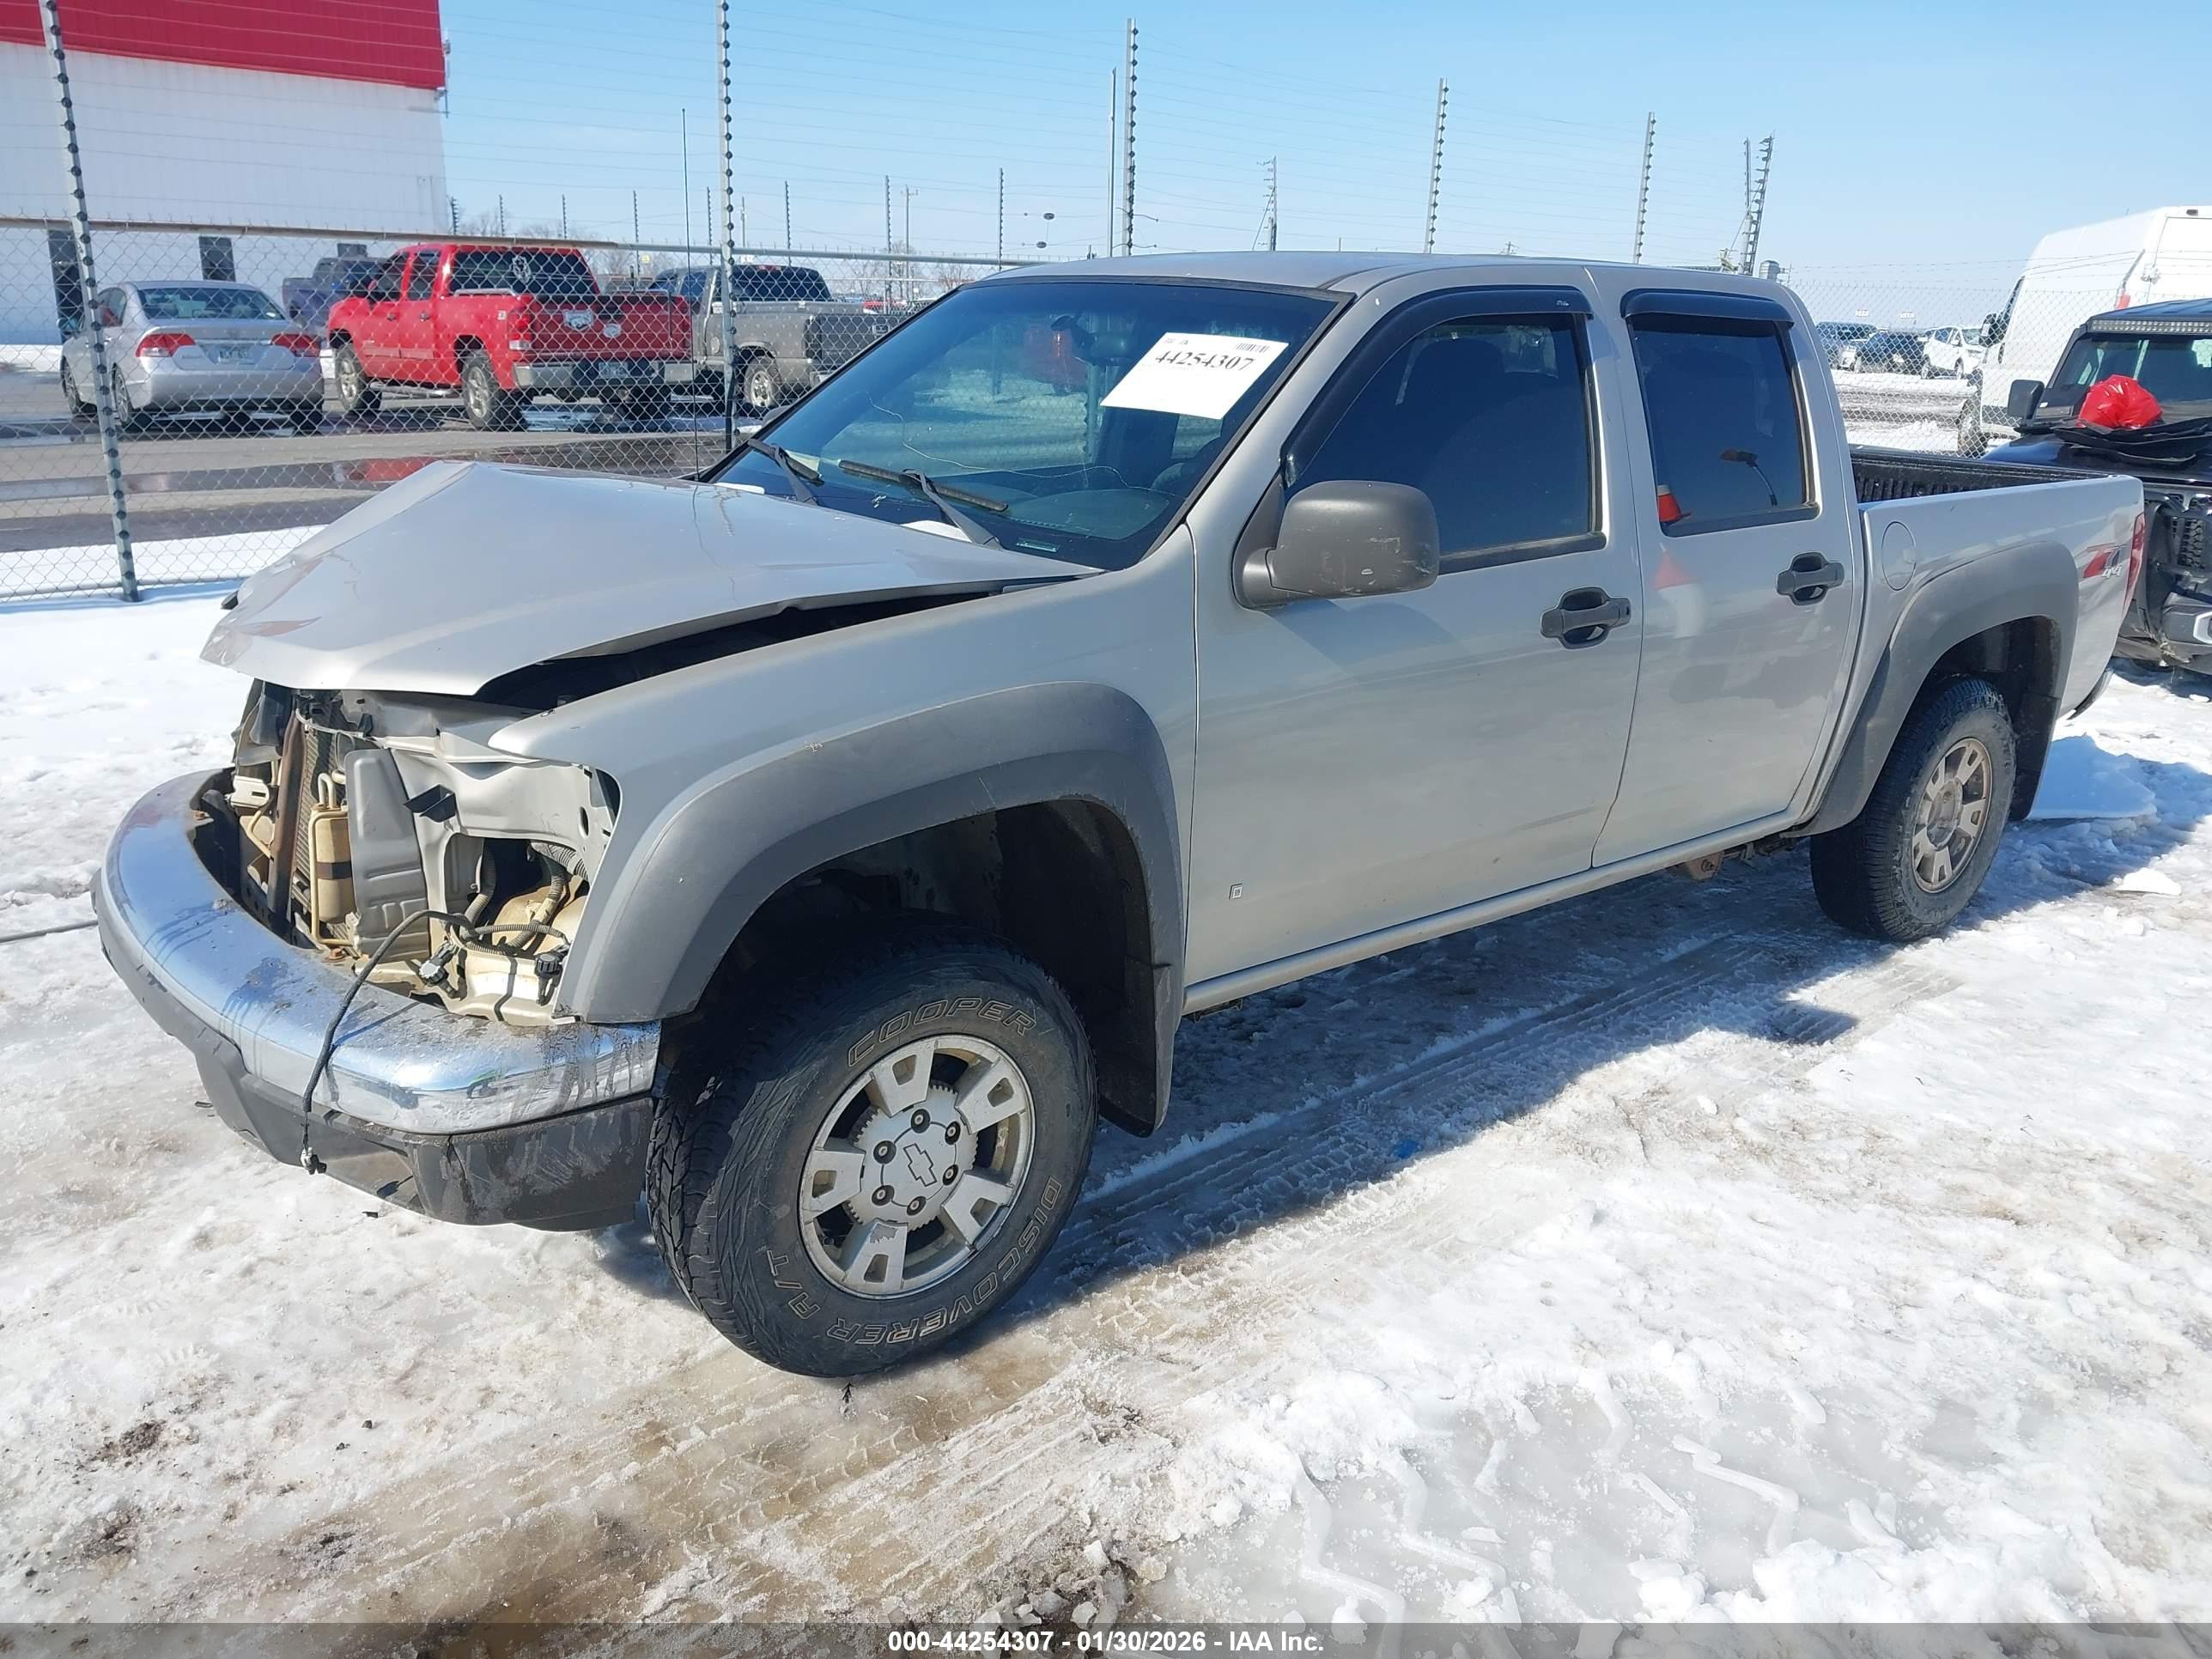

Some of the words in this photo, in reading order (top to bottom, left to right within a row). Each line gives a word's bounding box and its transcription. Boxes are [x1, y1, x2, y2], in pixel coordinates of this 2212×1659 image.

[1154, 349, 1256, 371] 44254307
[848, 996, 1037, 1067] COOPER
[766, 1249, 821, 1320] A/T
[826, 1176, 1062, 1346] DISCOVERER
